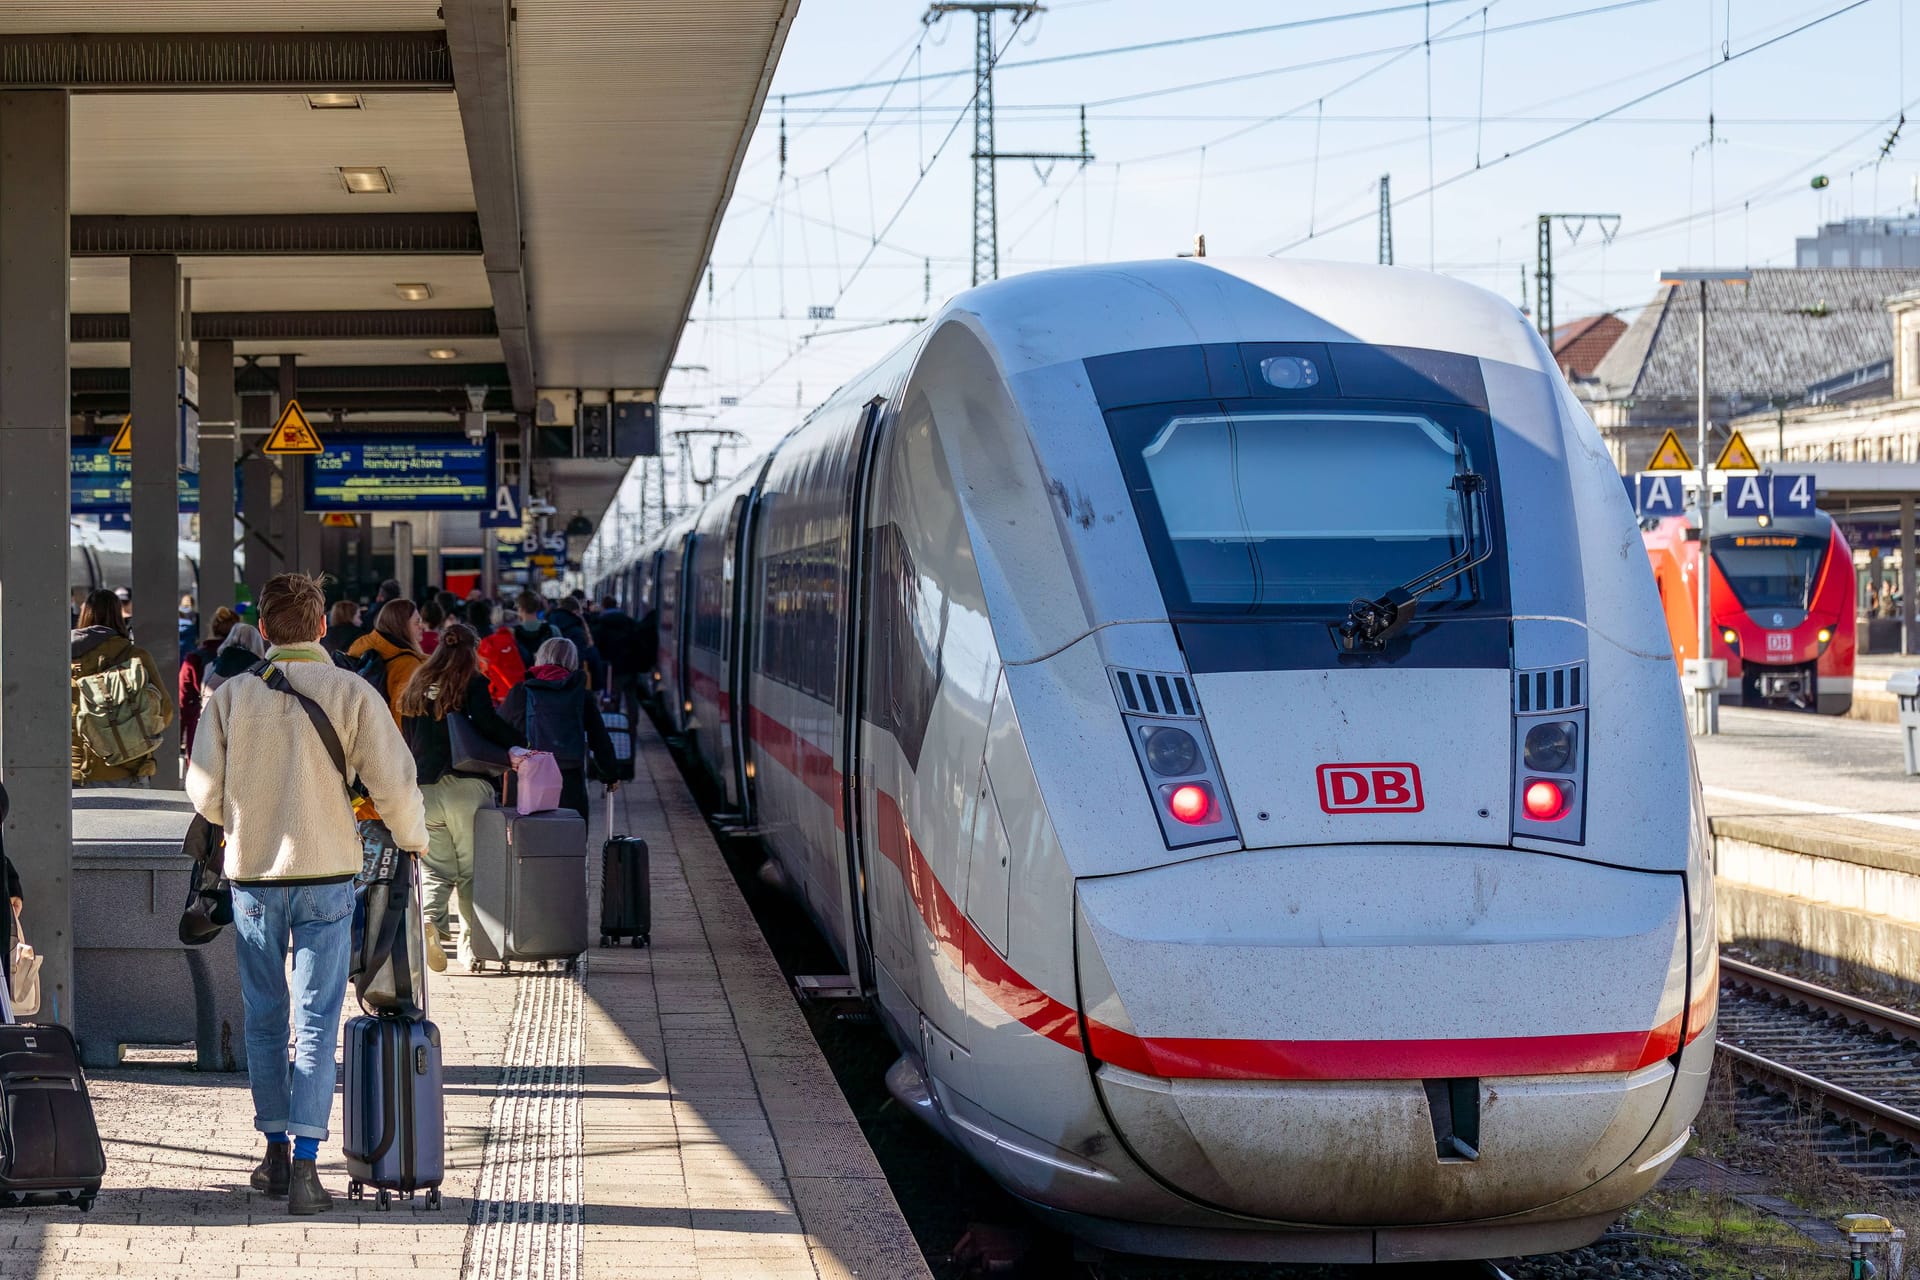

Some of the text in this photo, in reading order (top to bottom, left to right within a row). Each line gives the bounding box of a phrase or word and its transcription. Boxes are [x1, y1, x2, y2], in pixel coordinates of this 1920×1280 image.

[316, 459, 343, 470] 12:05
[363, 458, 443, 471] Hamburg-Altona
[489, 485, 518, 519] A
[1646, 476, 1673, 510] A
[1737, 476, 1812, 510] A 4
[1329, 770, 1412, 806] DB
